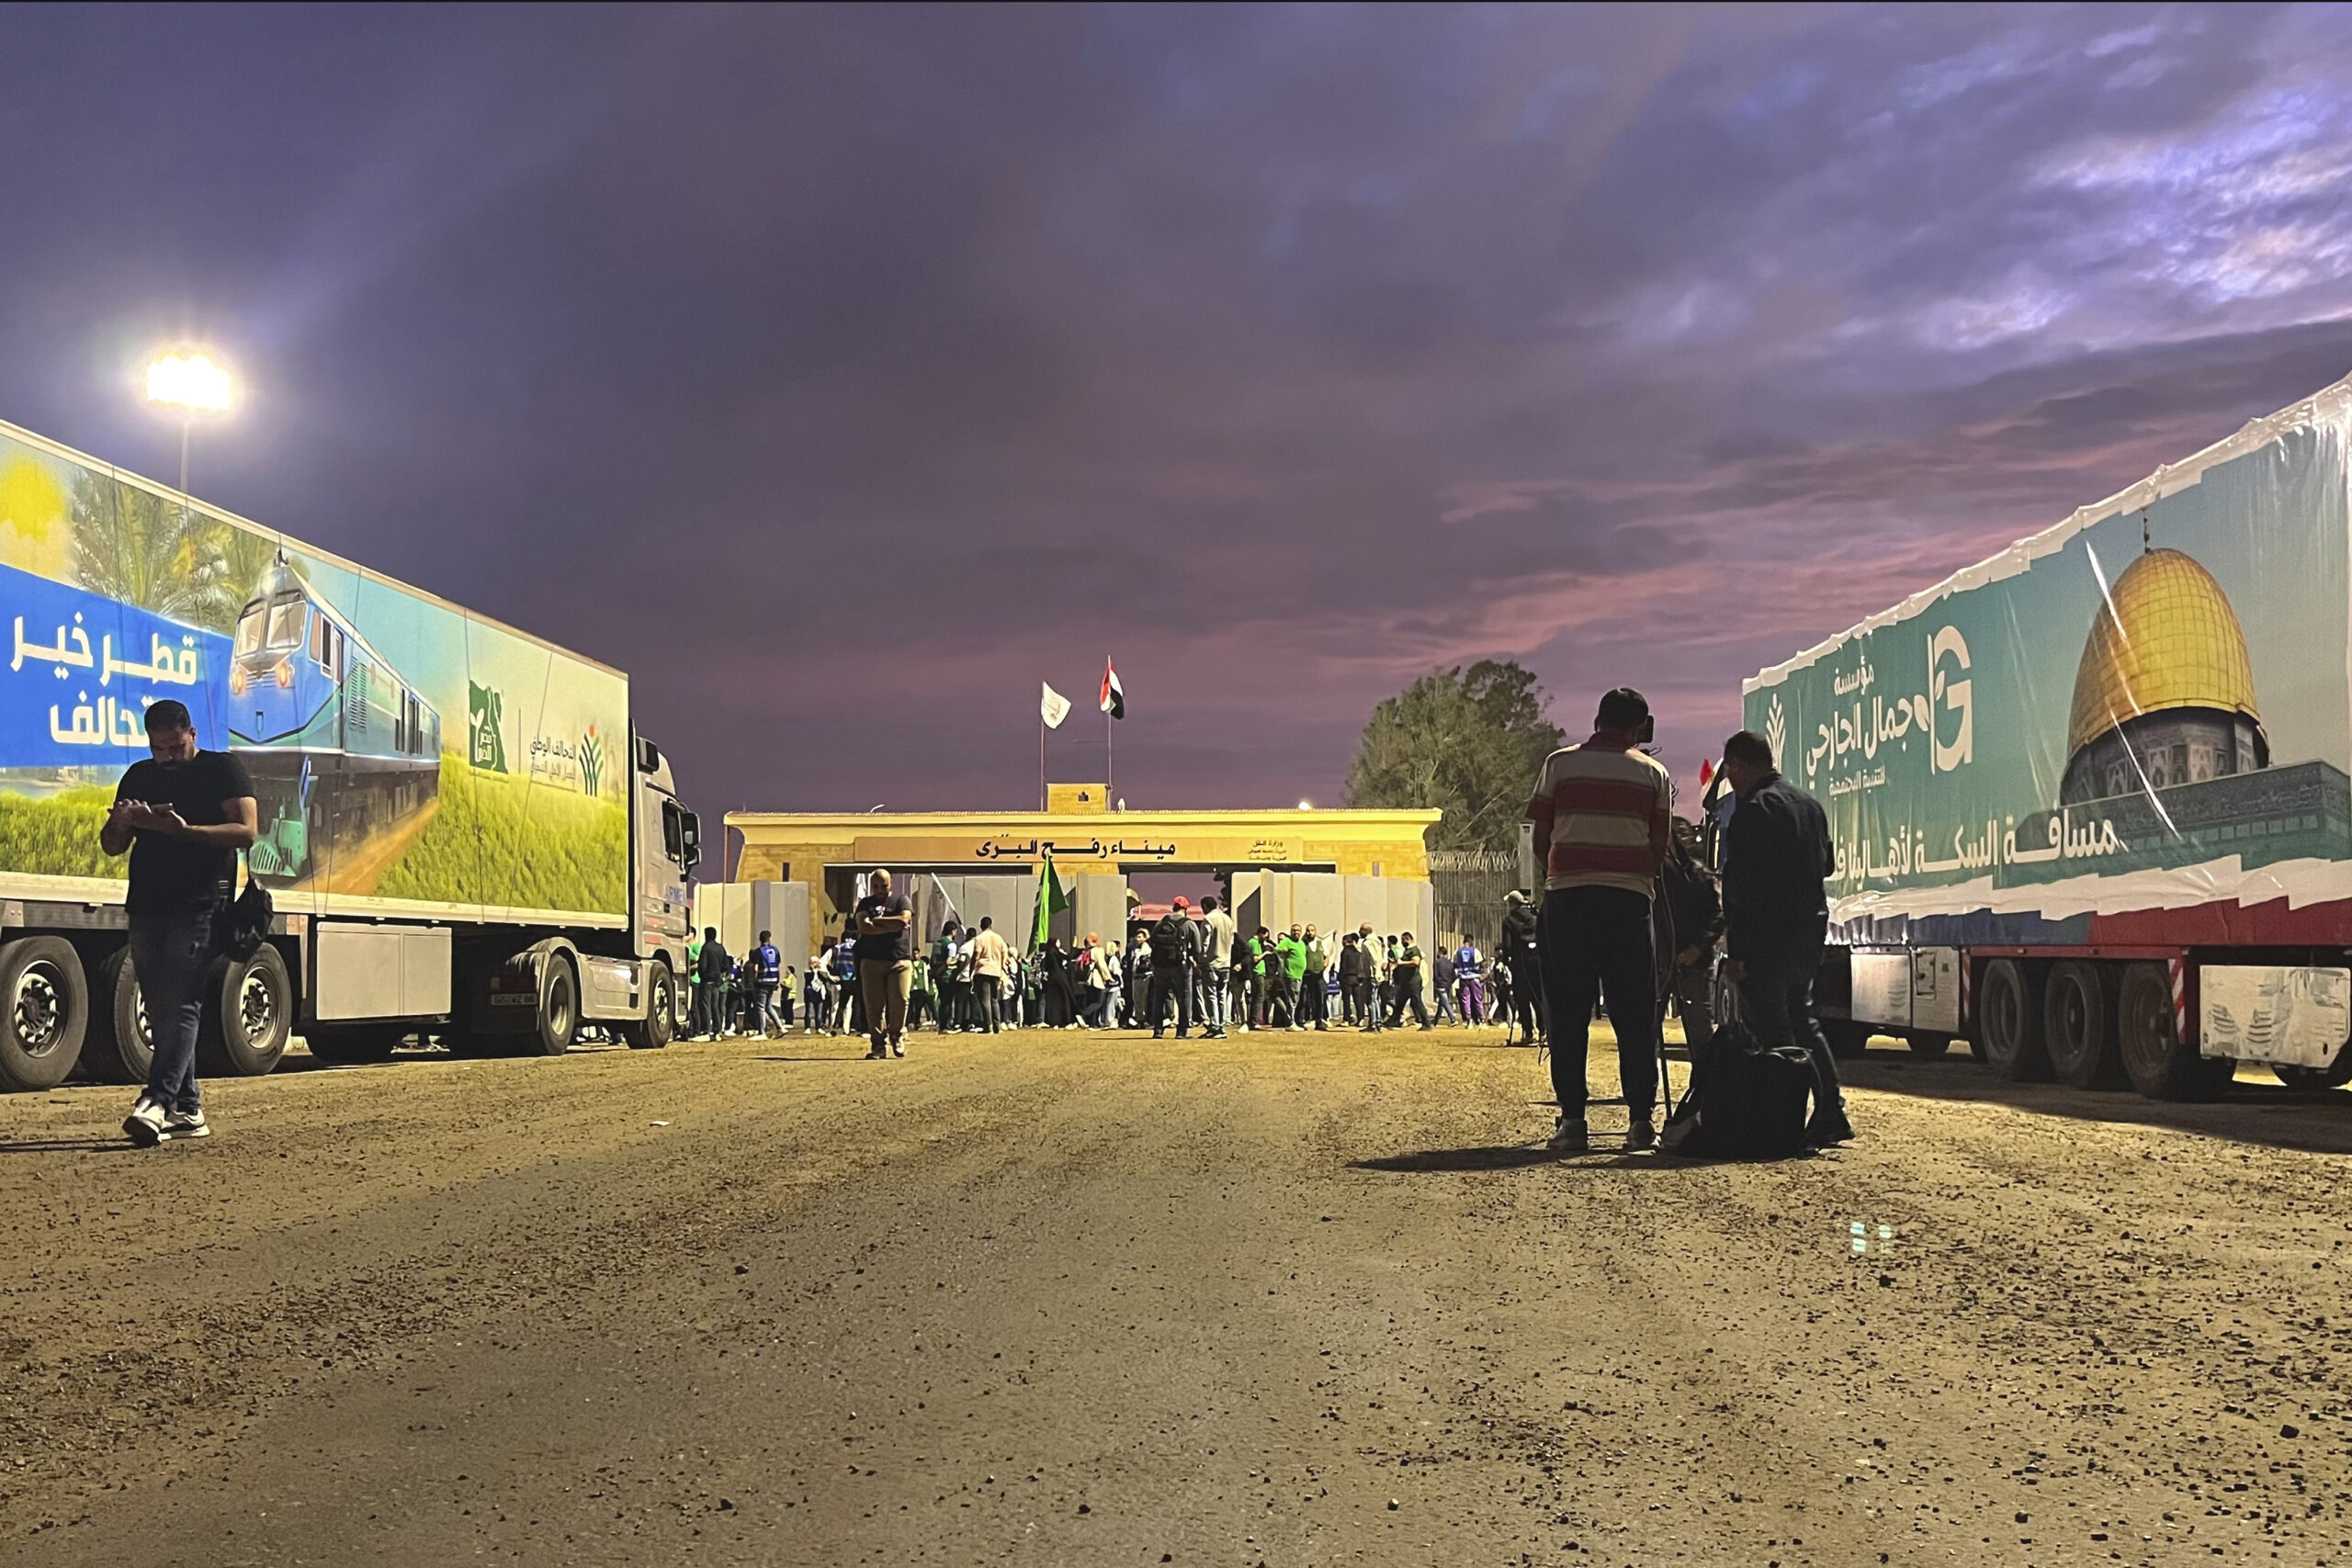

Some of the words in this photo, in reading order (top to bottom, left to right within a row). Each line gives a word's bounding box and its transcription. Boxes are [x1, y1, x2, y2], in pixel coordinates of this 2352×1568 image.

[10, 611, 94, 681] خير
[99, 632, 198, 687] قطر
[1834, 655, 1875, 696] مؤسسة
[1806, 702, 1862, 790] الجارحي
[1864, 695, 1913, 760] جمال
[1862, 763, 1886, 795] للتنمية
[1041, 837, 1108, 860] رفح
[1110, 839, 1176, 860] ميناء
[1849, 825, 1911, 890] لأهالينا
[1915, 819, 1998, 874] السكة
[2003, 799, 2116, 864] مسافة
